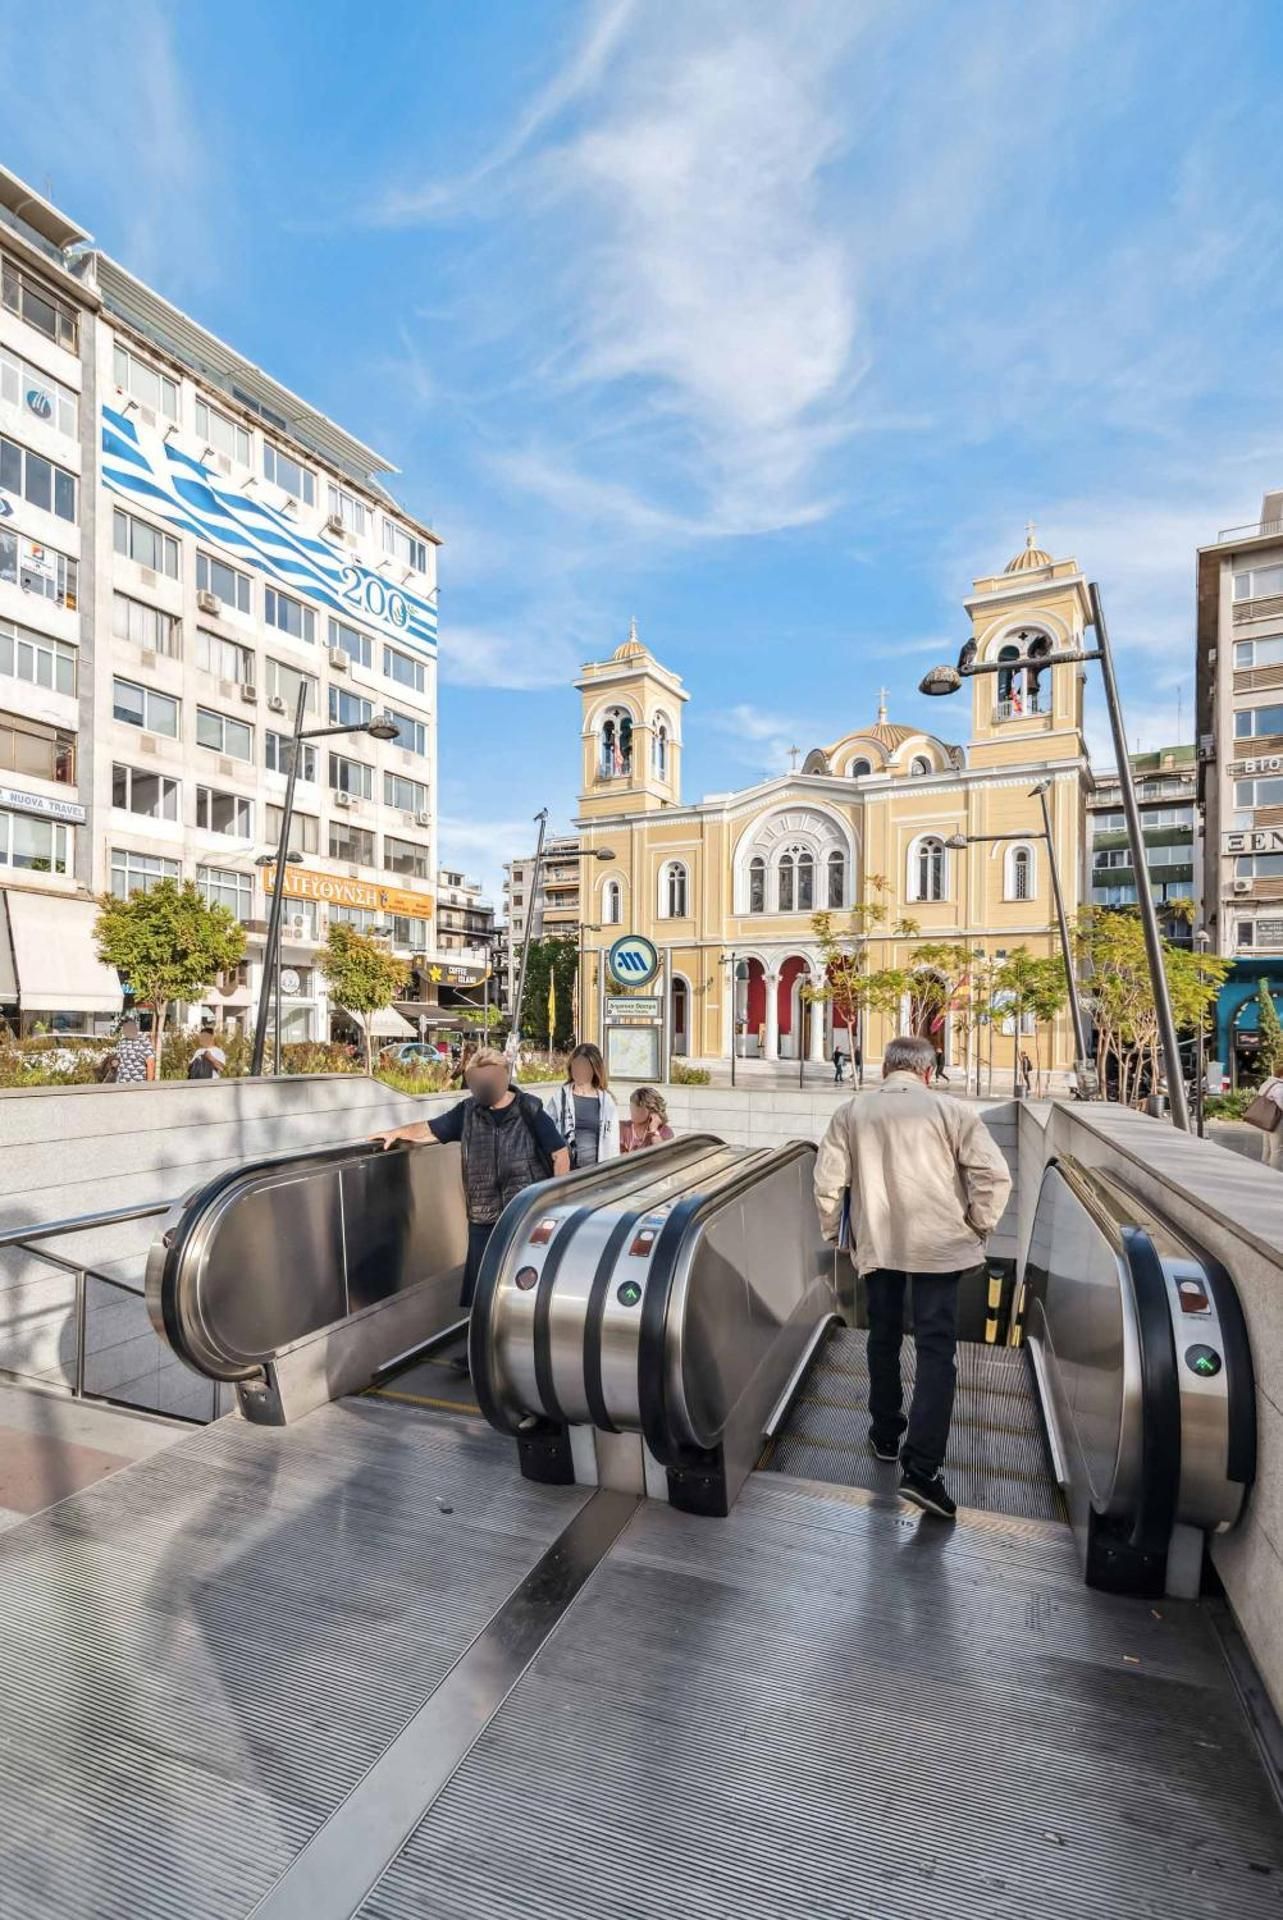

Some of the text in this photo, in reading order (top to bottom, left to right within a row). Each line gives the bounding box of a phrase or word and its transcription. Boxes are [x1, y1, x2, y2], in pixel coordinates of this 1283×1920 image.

[342, 567, 406, 627] 200
[10, 792, 43, 808] NUOVA
[49, 802, 83, 817] TRAVEL
